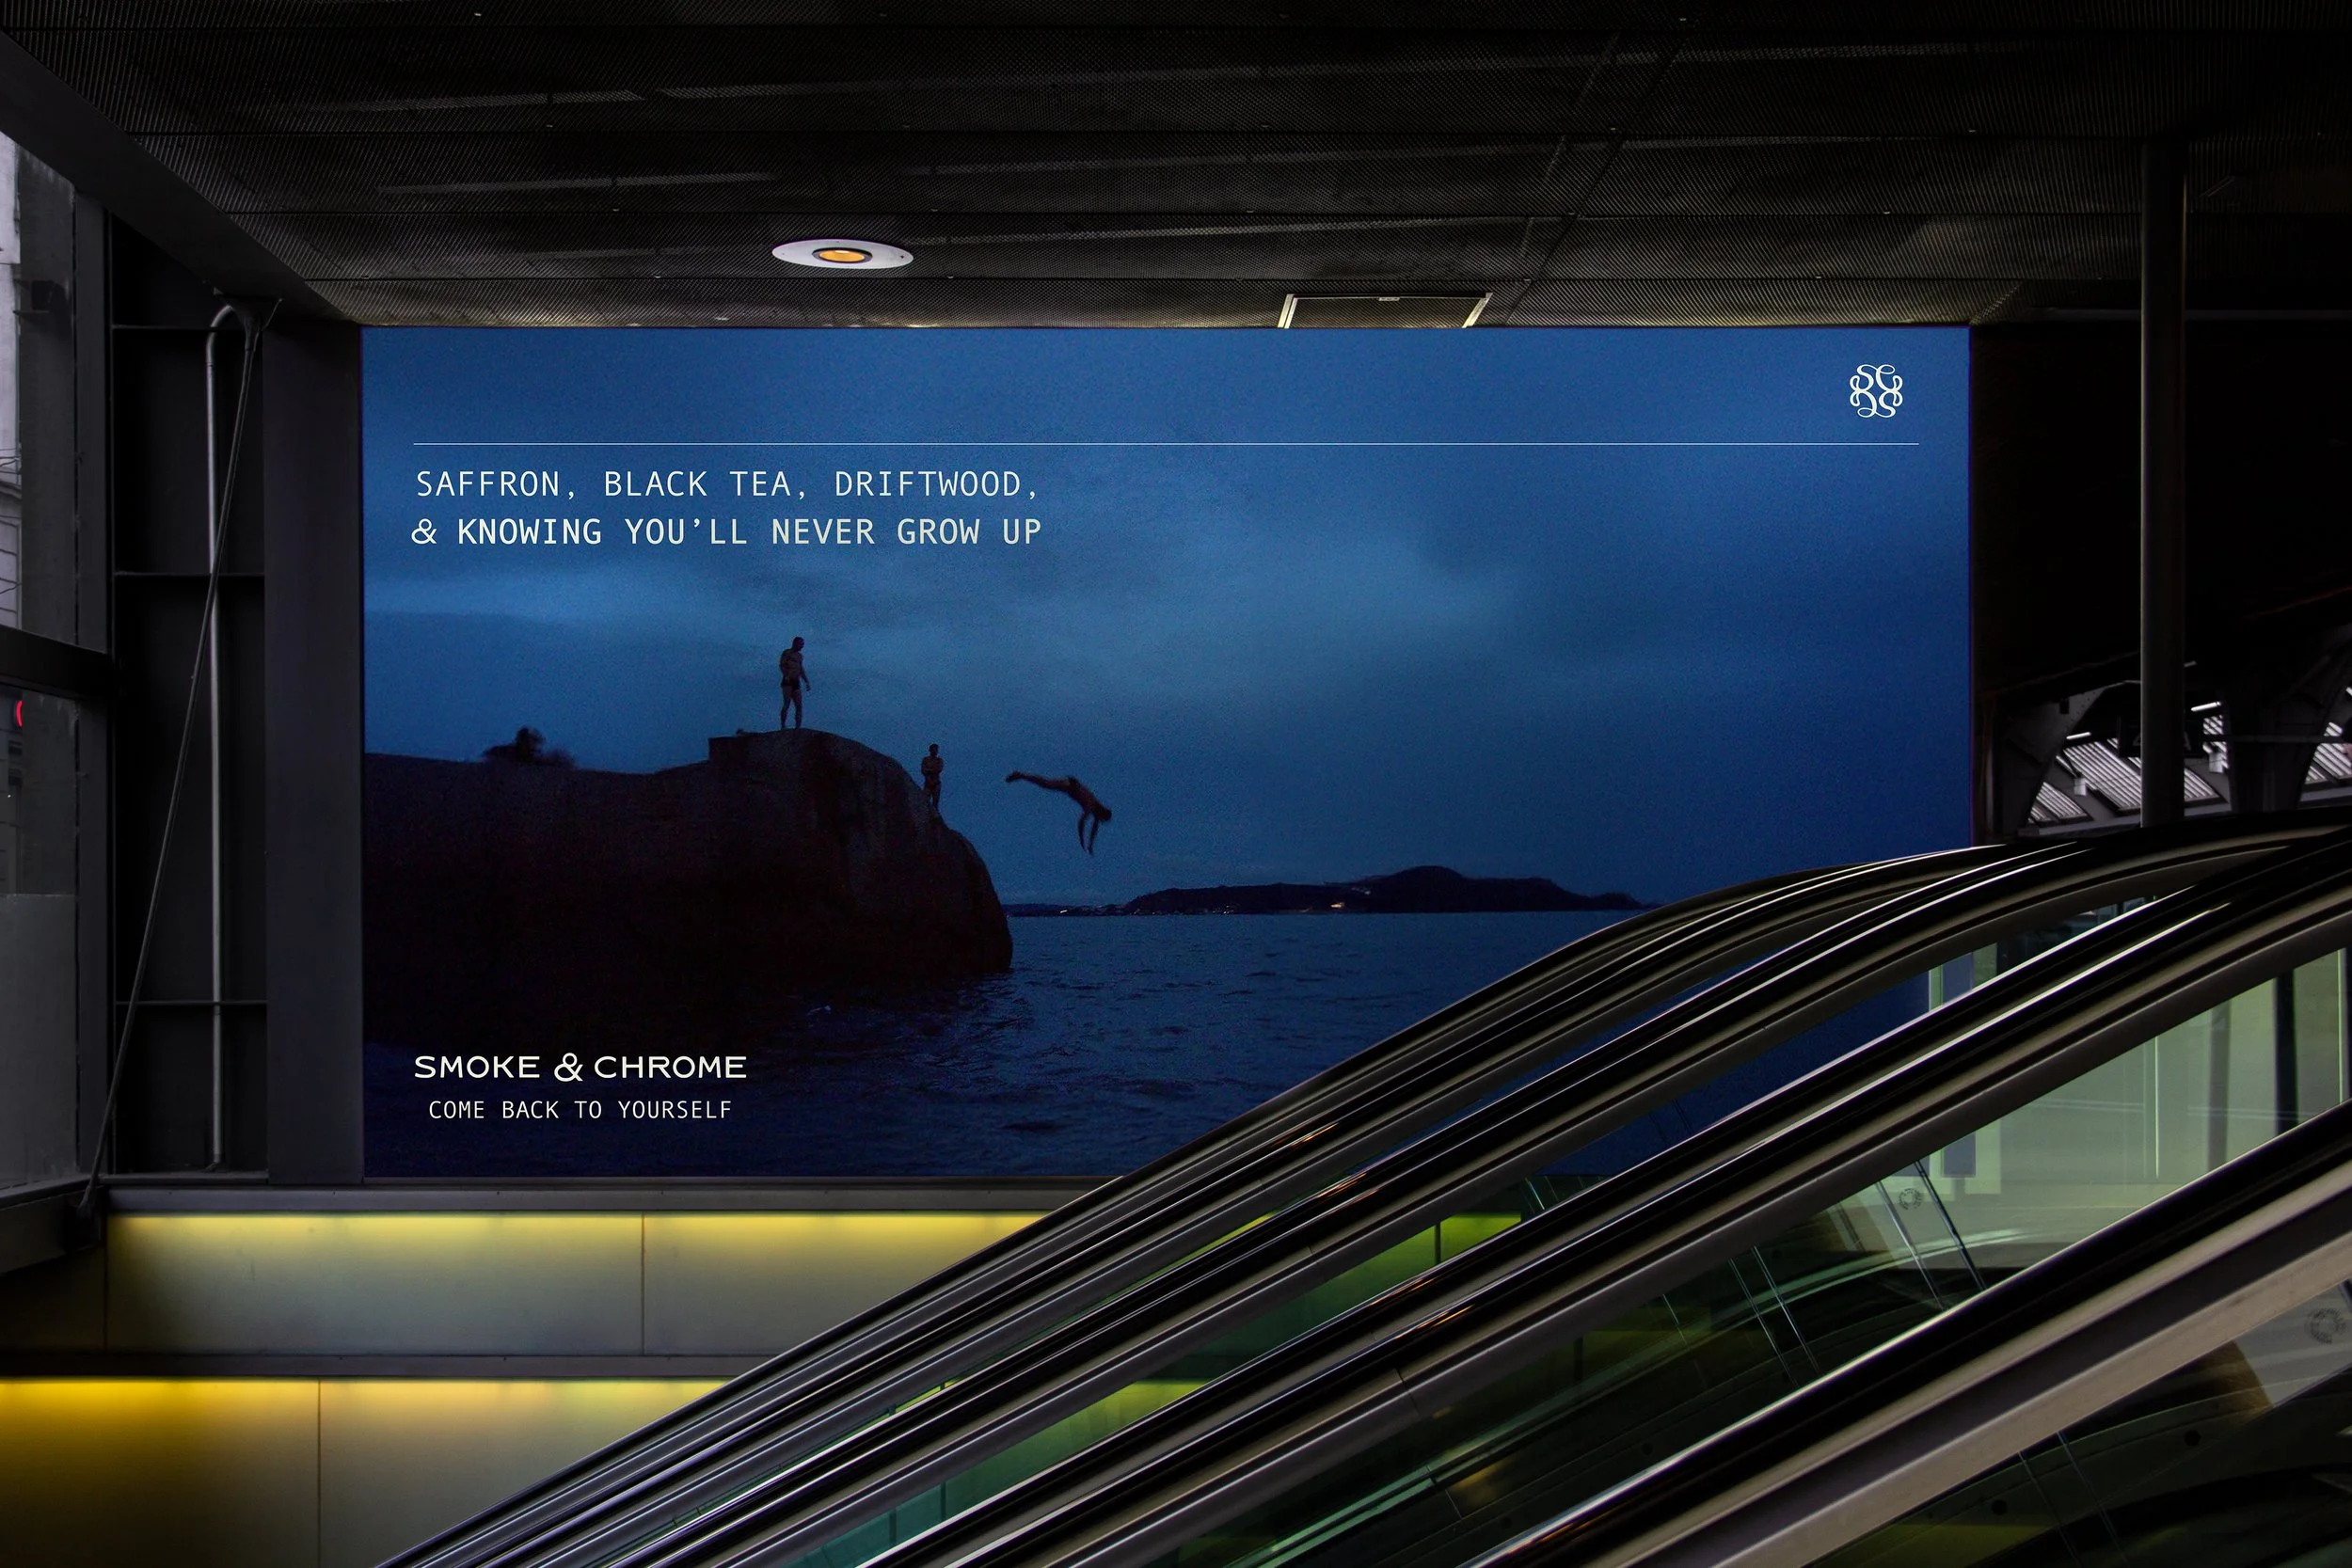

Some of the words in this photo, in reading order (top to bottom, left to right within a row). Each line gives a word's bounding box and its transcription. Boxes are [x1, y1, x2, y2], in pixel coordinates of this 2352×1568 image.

[417, 470, 574, 500] SAFFRON,
[605, 470, 707, 497] BLACK
[729, 470, 805, 500] TEA,
[835, 470, 1036, 500] DRIFTWOOD,
[411, 517, 437, 545] &
[458, 517, 601, 545] KNOWING
[624, 517, 747, 545] YOU’LL
[772, 518, 875, 545] NEVER
[897, 517, 980, 545] GROW
[1003, 518, 1041, 545] UP
[414, 1055, 540, 1079] SMOKE
[553, 1052, 585, 1083] &
[594, 1055, 747, 1079] CHROME
[429, 1101, 485, 1119] COME
[502, 1101, 559, 1119] BACK
[574, 1101, 602, 1119] TO
[617, 1100, 731, 1119] YOURSELF
